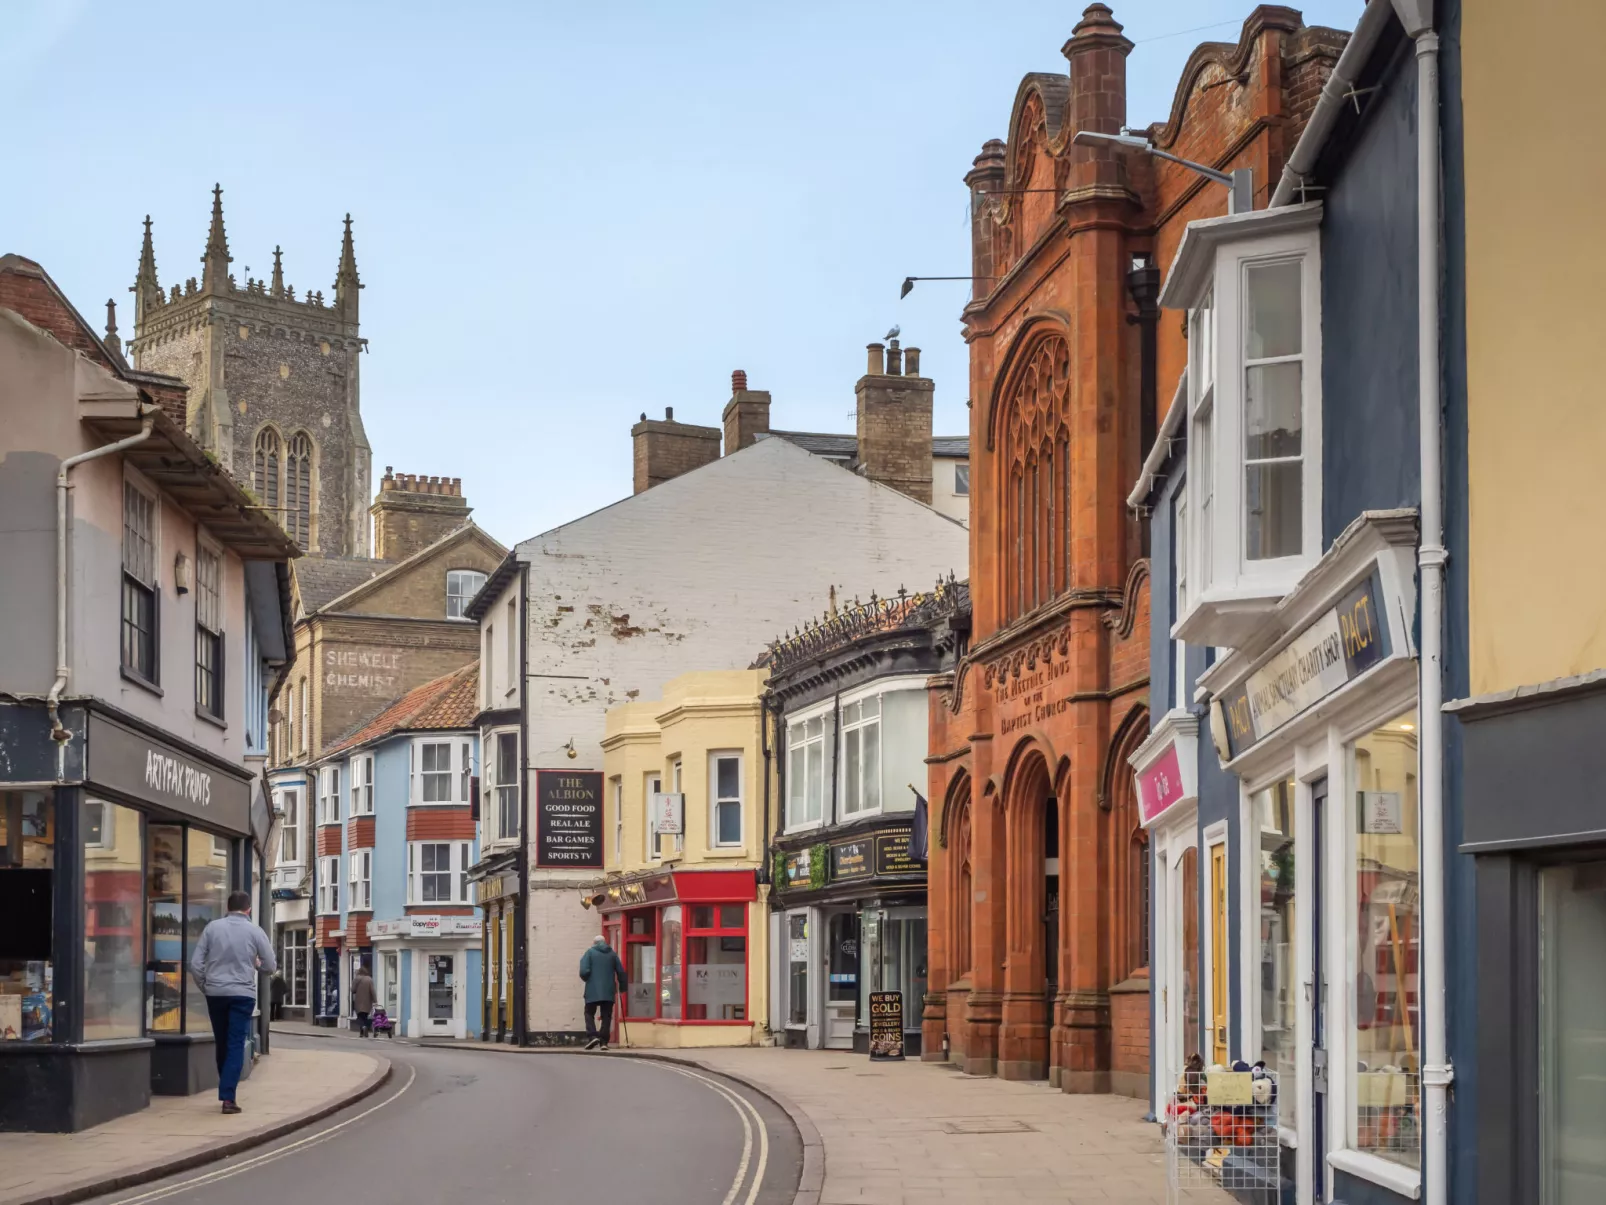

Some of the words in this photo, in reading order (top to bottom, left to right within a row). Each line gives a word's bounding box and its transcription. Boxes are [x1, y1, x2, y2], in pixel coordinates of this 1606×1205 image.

[1229, 696, 1250, 740] PACT
[1268, 661, 1300, 707] SANCTUARY
[1298, 643, 1326, 686] CHARITY
[1322, 632, 1341, 667] SHOP
[1340, 595, 1373, 659] PACT
[326, 673, 395, 687] CHEMIST
[1011, 672, 1044, 698] MEETING
[1047, 660, 1071, 681] HOUS
[1001, 711, 1032, 735] BAPTIST
[1035, 698, 1067, 722] CHURCH
[145, 749, 185, 797] ARTYFAX
[185, 765, 211, 807] PRINTS
[557, 778, 583, 788] THE
[547, 789, 595, 800] ALBION
[545, 804, 571, 812] GOOD
[572, 805, 596, 813] FOOD
[550, 820, 573, 828] REAL
[573, 820, 591, 828] ALE
[564, 836, 595, 844] GAMES
[547, 852, 580, 860] SPORTS
[580, 852, 593, 860] TV
[696, 969, 738, 979] KATON
[884, 994, 900, 1002] BUY
[871, 1003, 901, 1013] GOLD
[872, 1032, 902, 1042] COINS
